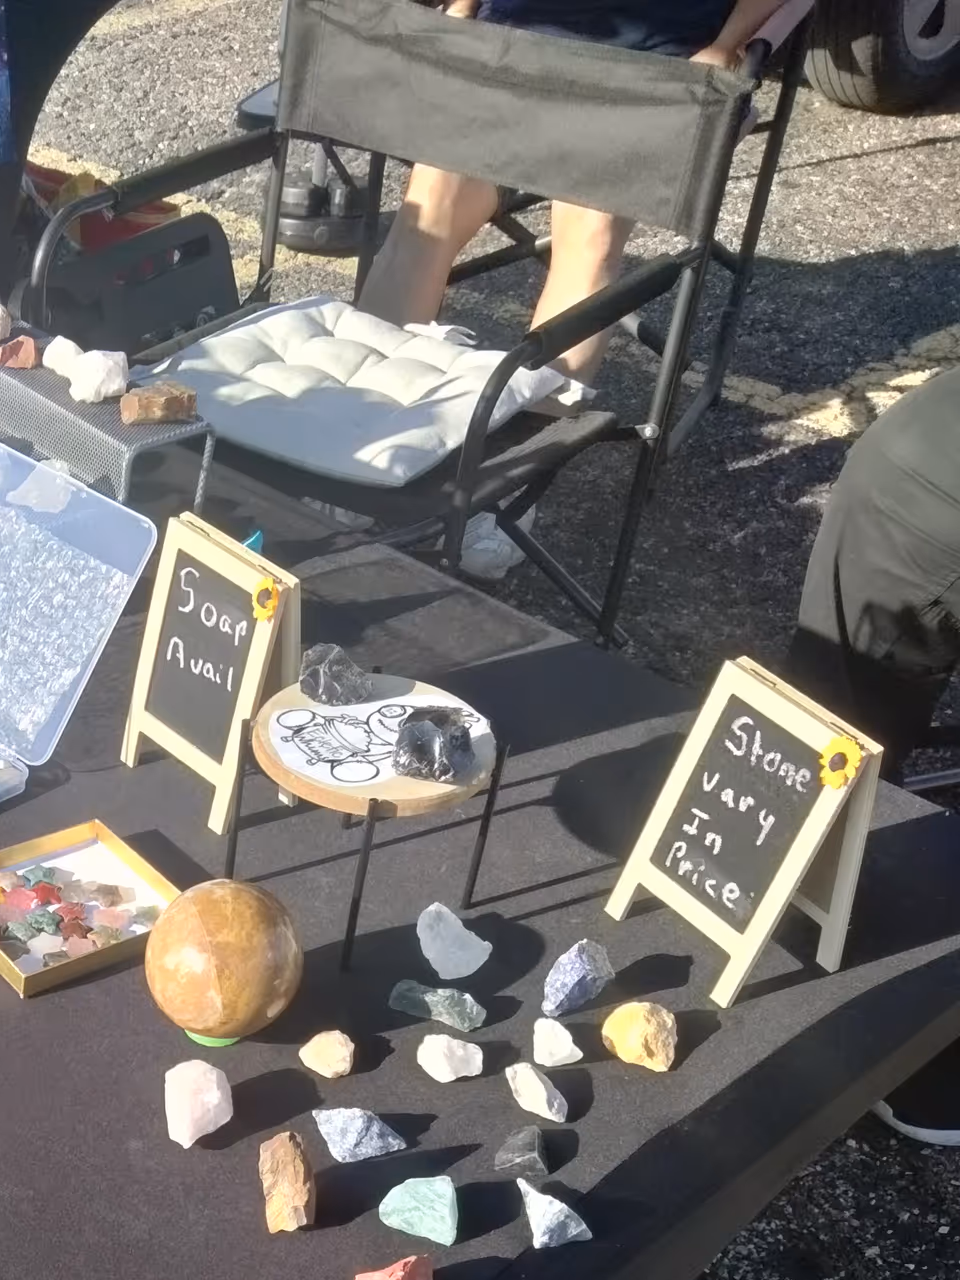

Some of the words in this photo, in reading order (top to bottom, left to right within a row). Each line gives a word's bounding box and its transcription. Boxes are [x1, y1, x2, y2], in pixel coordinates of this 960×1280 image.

[177, 566, 248, 647] Soap
[165, 635, 235, 693] Avail
[724, 715, 812, 793] Stone
